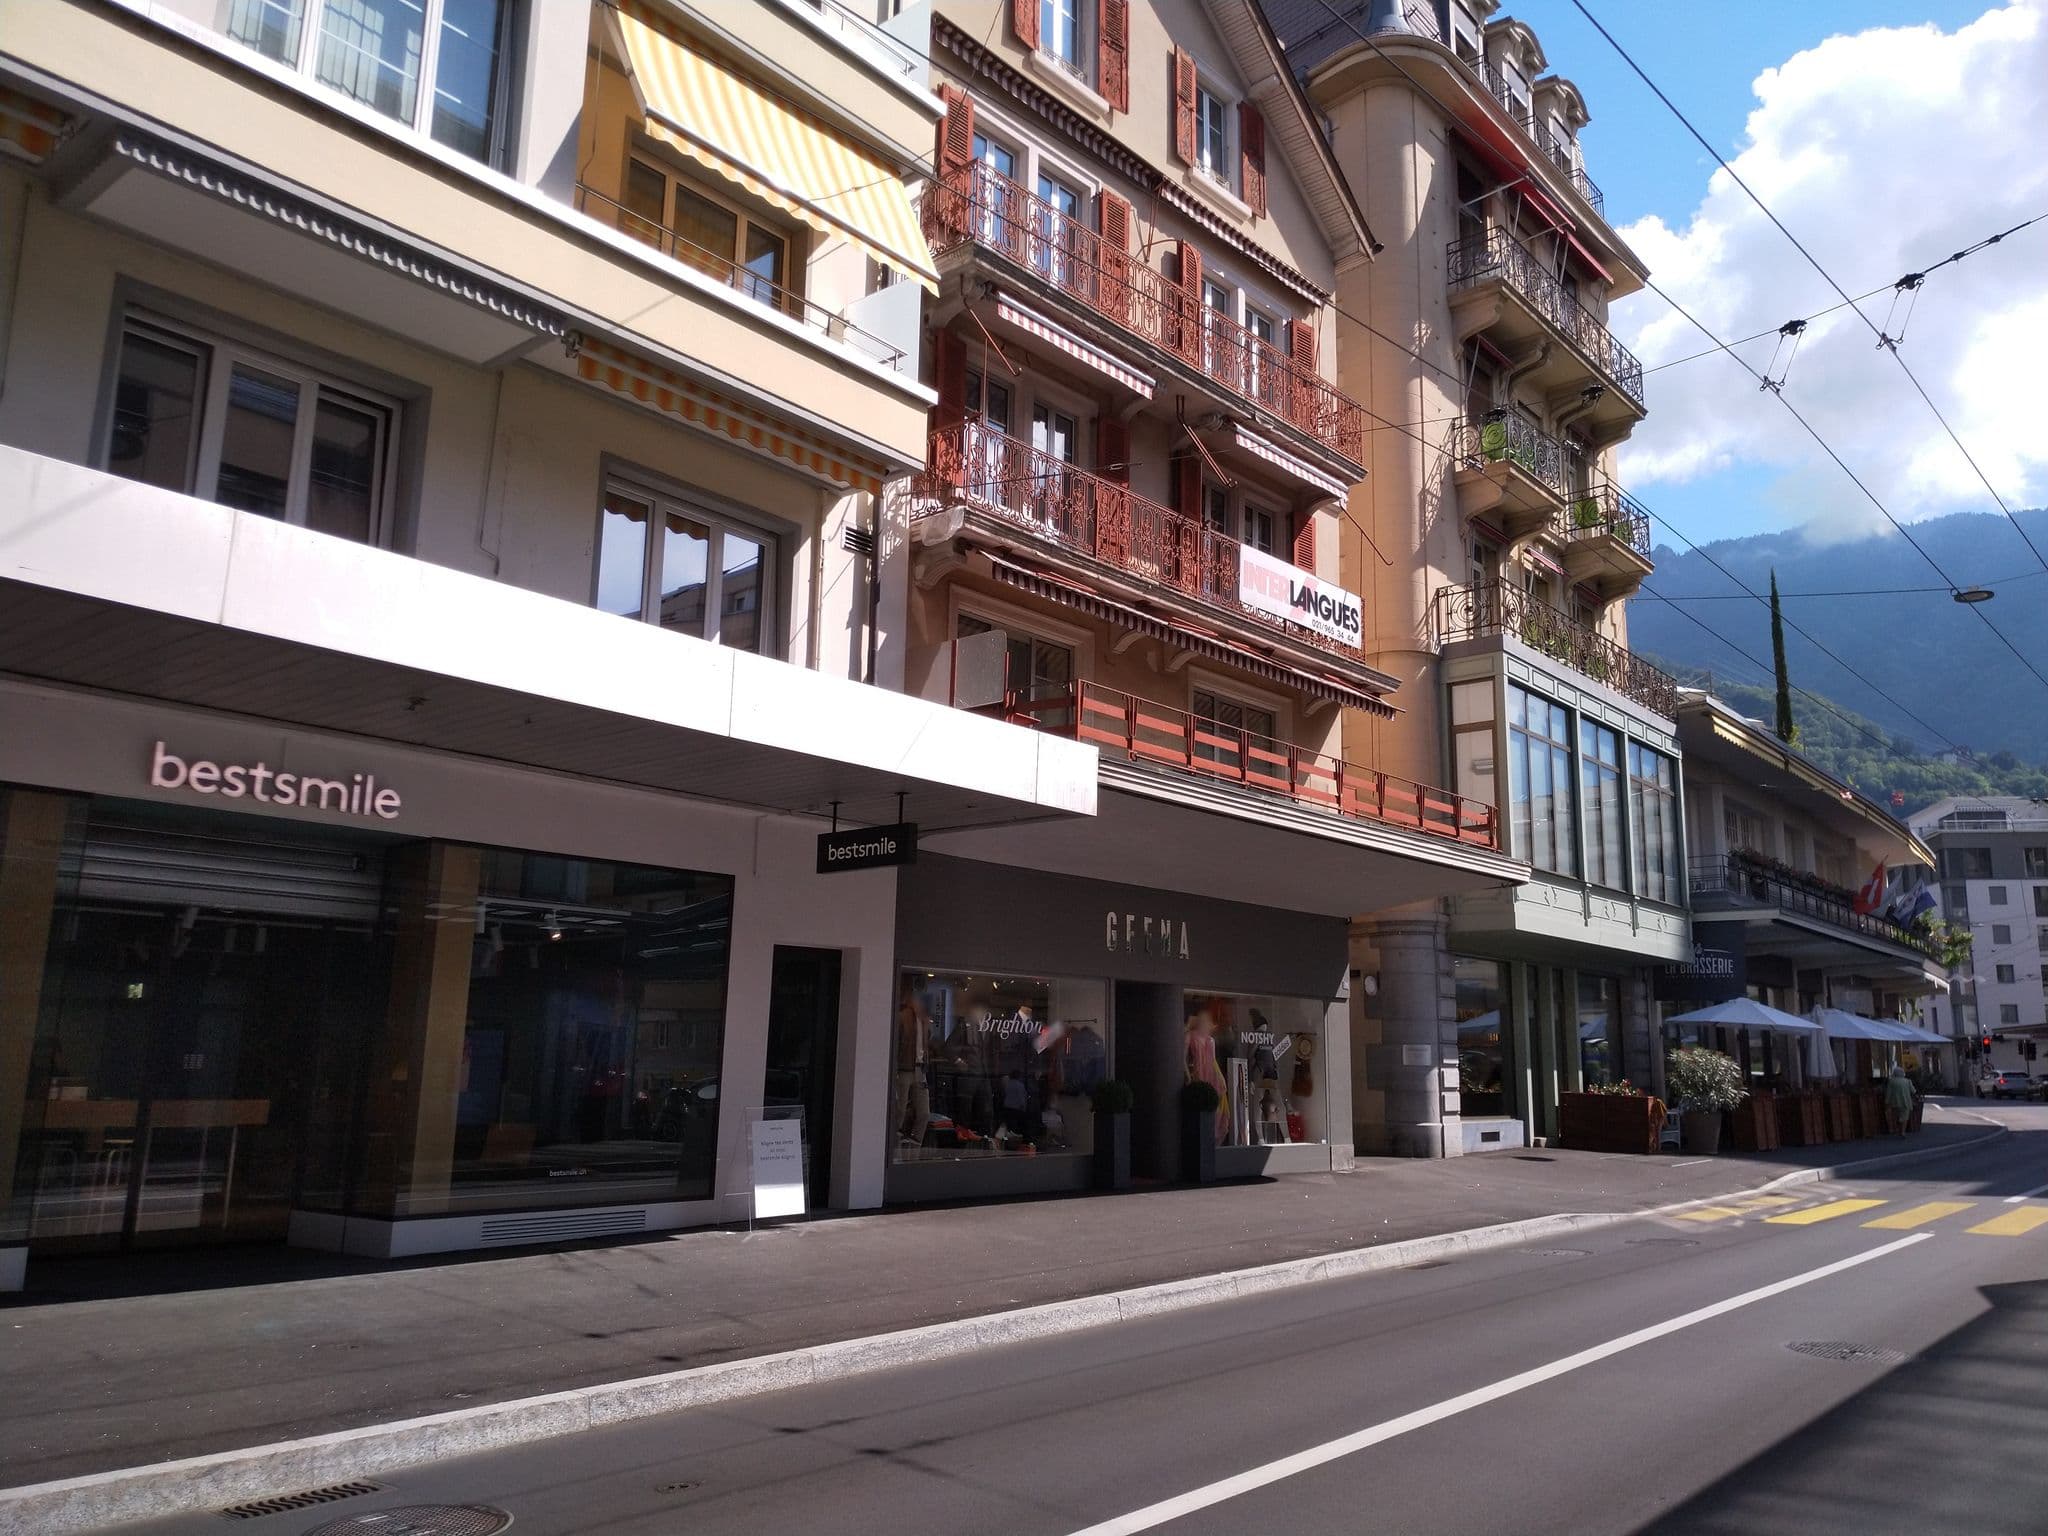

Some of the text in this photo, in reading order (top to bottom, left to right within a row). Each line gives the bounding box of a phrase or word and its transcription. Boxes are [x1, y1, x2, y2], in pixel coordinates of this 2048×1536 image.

[151, 741, 402, 820] bestsmile
[828, 837, 897, 861] bestsmile
[978, 1012, 1042, 1040] Brighton
[1241, 1031, 1274, 1045] NOTSHY
